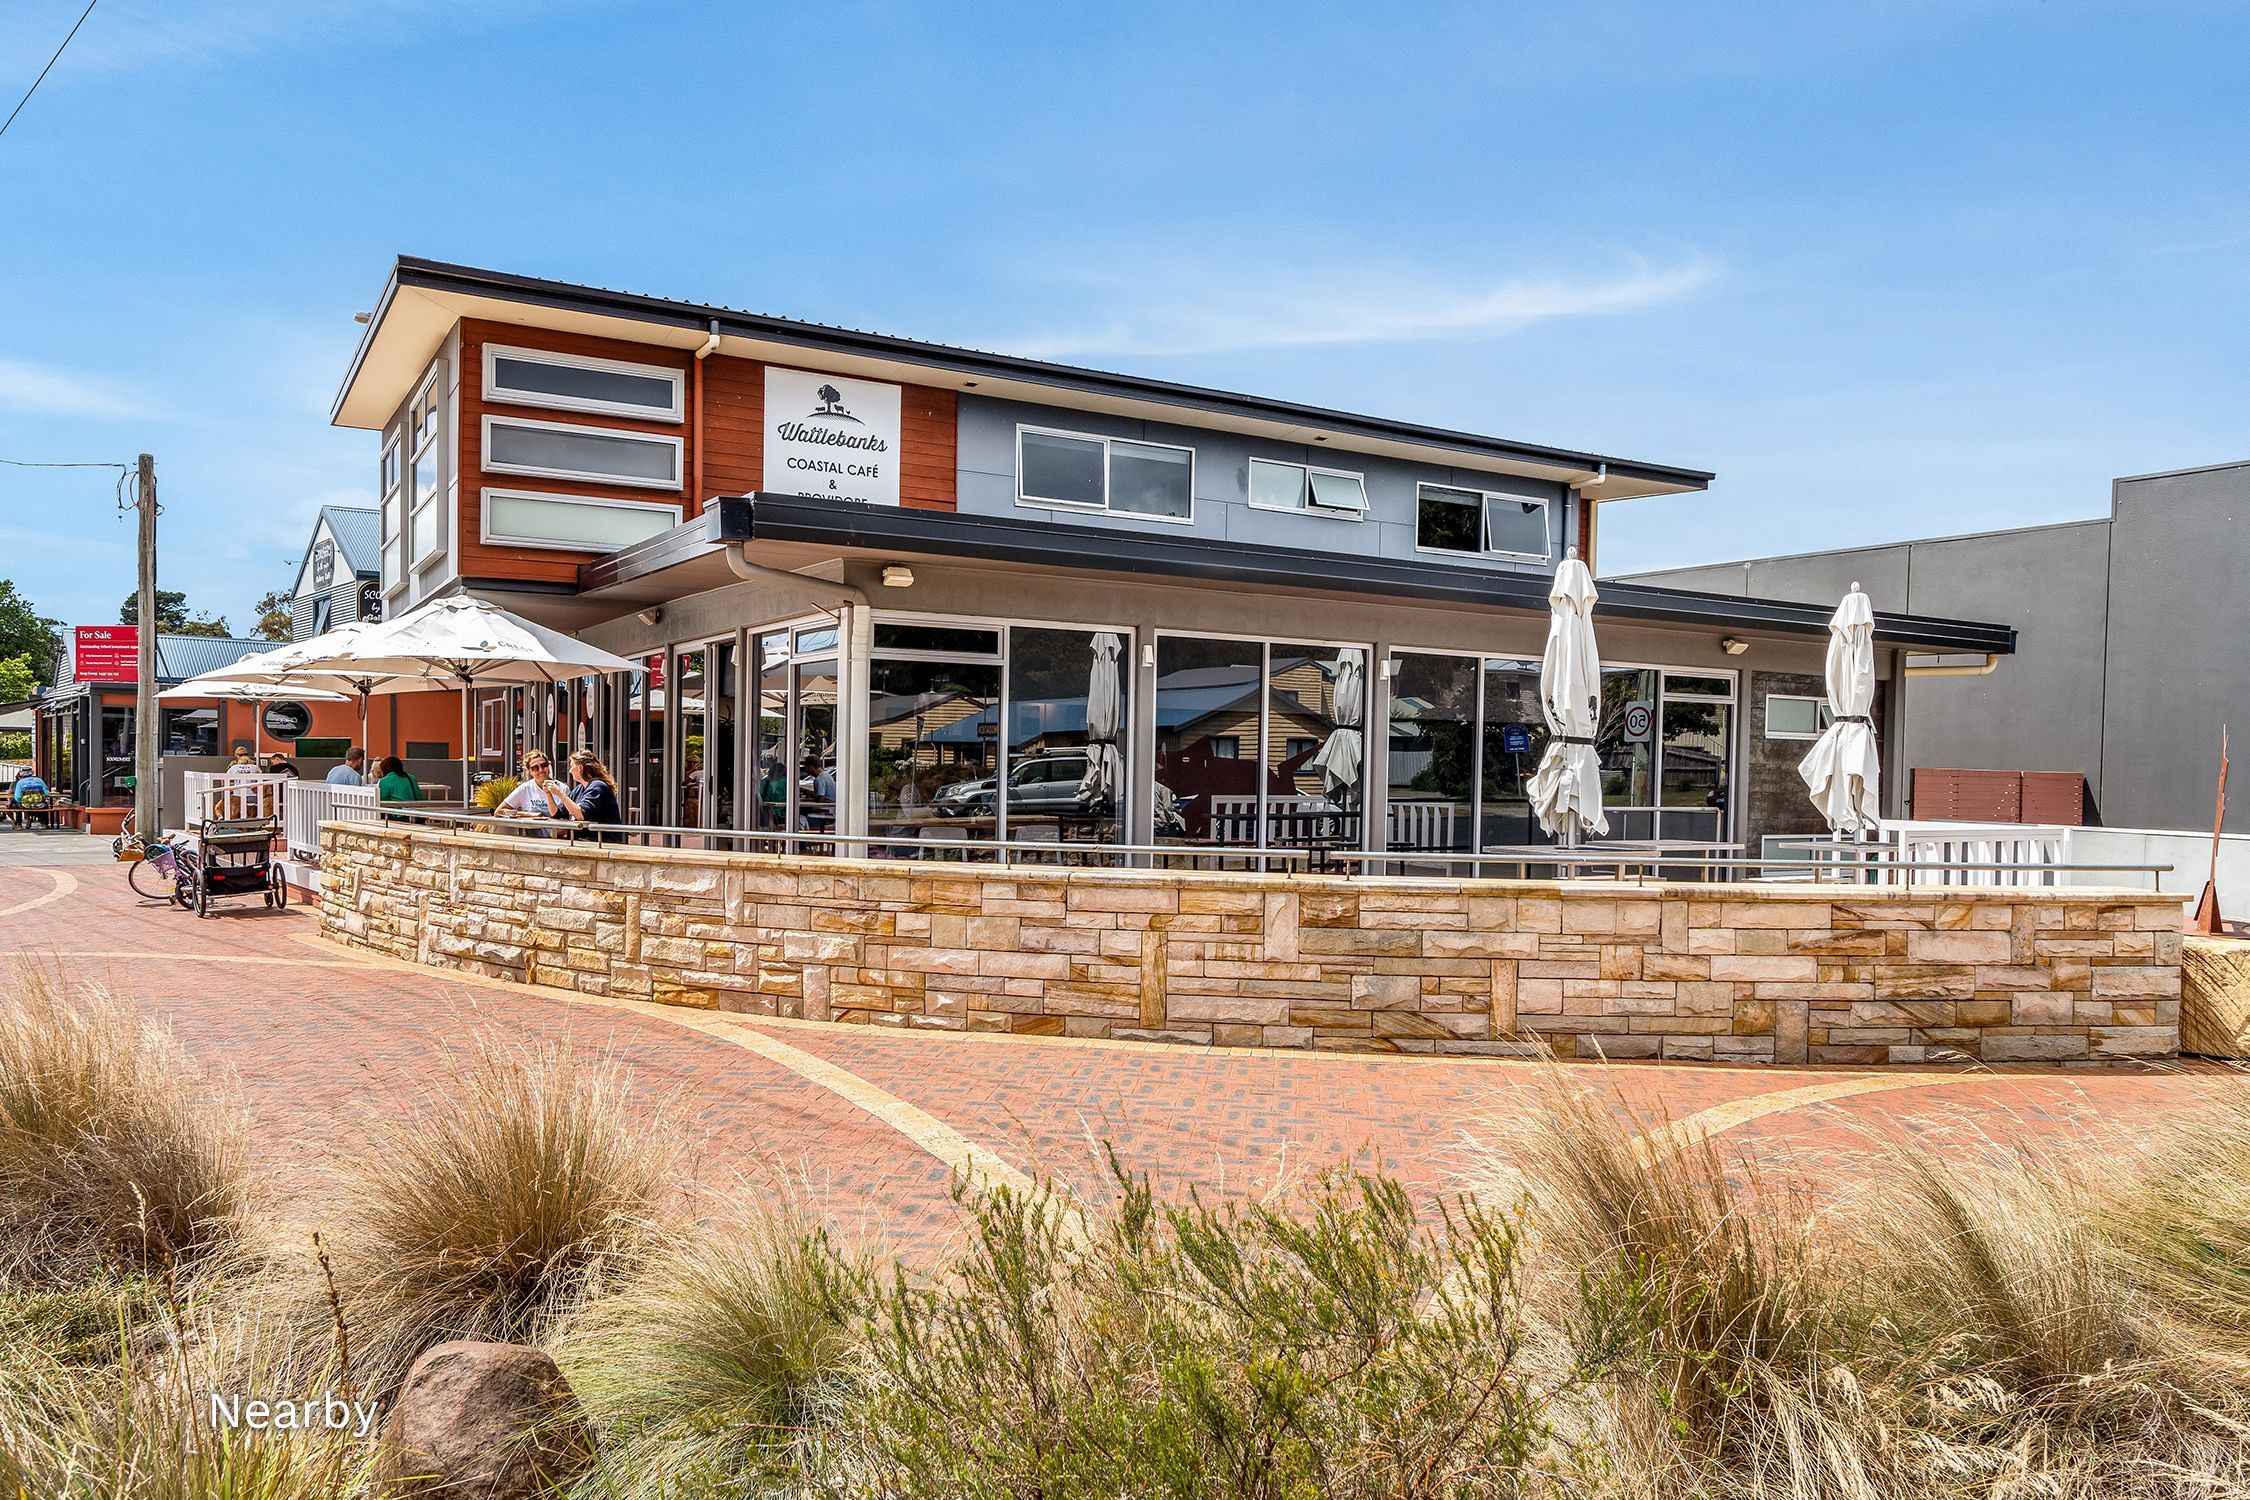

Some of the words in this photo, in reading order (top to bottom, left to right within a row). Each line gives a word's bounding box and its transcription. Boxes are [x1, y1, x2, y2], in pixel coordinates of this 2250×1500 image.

[777, 422, 888, 453] Wattlebanks
[787, 457, 843, 474] COASTAL
[847, 464, 879, 478] CAFÉ
[828, 479, 837, 490] &
[80, 631, 93, 639] For
[94, 631, 112, 639] Sale
